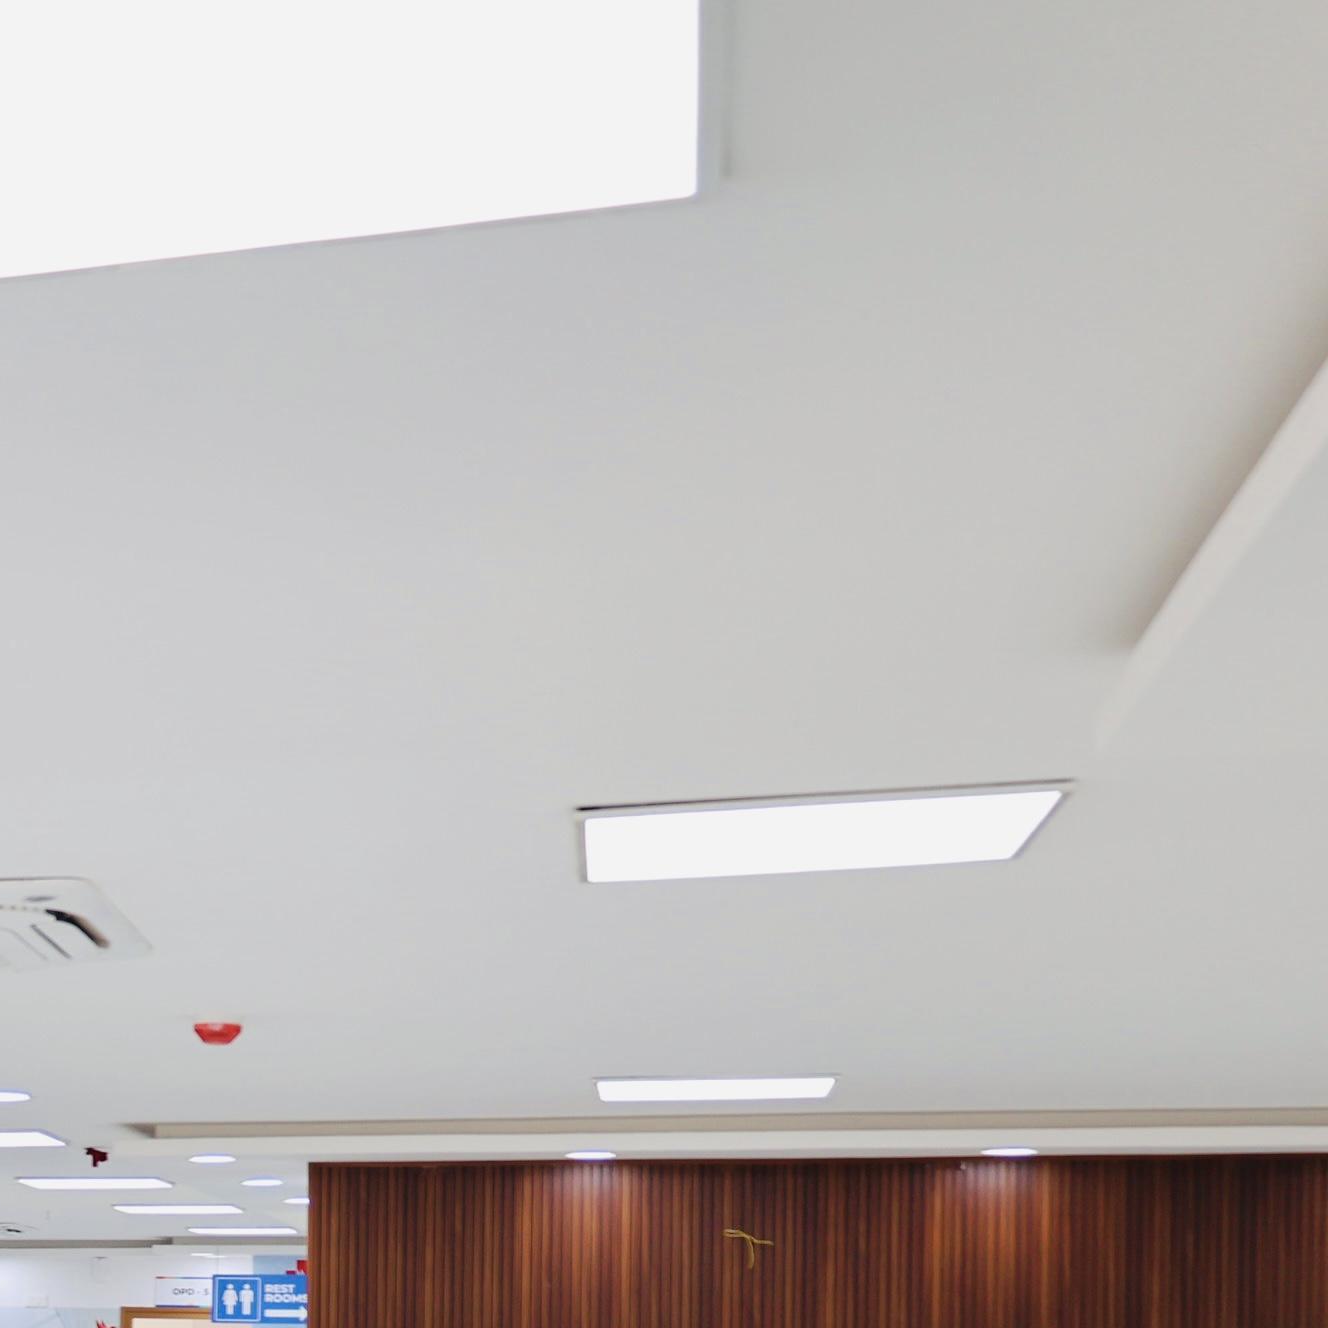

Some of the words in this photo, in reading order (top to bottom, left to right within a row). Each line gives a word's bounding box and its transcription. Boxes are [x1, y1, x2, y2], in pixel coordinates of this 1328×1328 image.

[172, 1288, 195, 1296] OPD
[264, 1284, 296, 1293] REST
[264, 1293, 308, 1303] ROOMS
